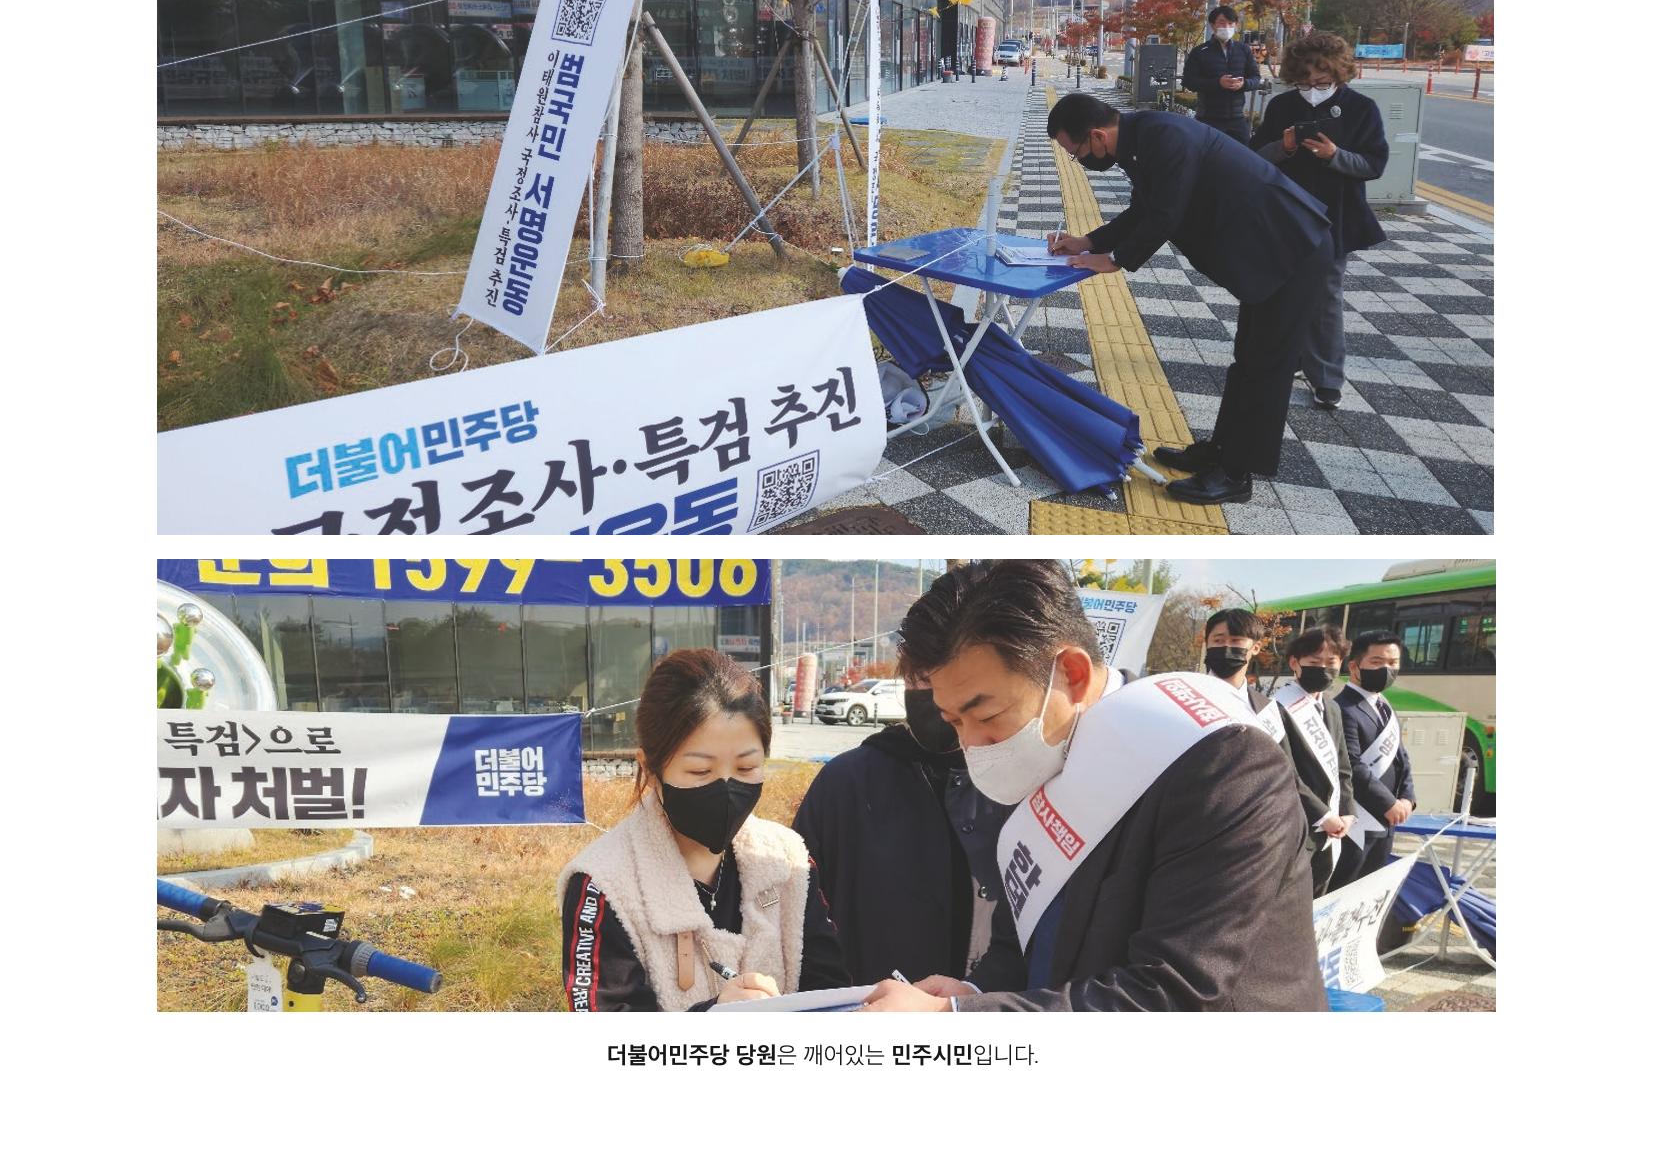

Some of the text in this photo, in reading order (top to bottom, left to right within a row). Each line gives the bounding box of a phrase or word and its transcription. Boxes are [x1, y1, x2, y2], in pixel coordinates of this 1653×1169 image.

[526, 50, 560, 143] 이태원참사
[502, 53, 585, 317] 범국민 서명운동
[485, 269, 504, 308] 추진
[763, 366, 862, 448] 추진
[284, 400, 540, 499] 더불어민주당
[1081, 596, 1138, 614] 불어민주당
[164, 719, 342, 758] 특검>으로
[474, 745, 543, 772] 더불어
[157, 766, 368, 821] 자 처벌!
[475, 771, 548, 798] 민주당
[580, 897, 597, 924] AND
[575, 926, 595, 986] CREATIVE
